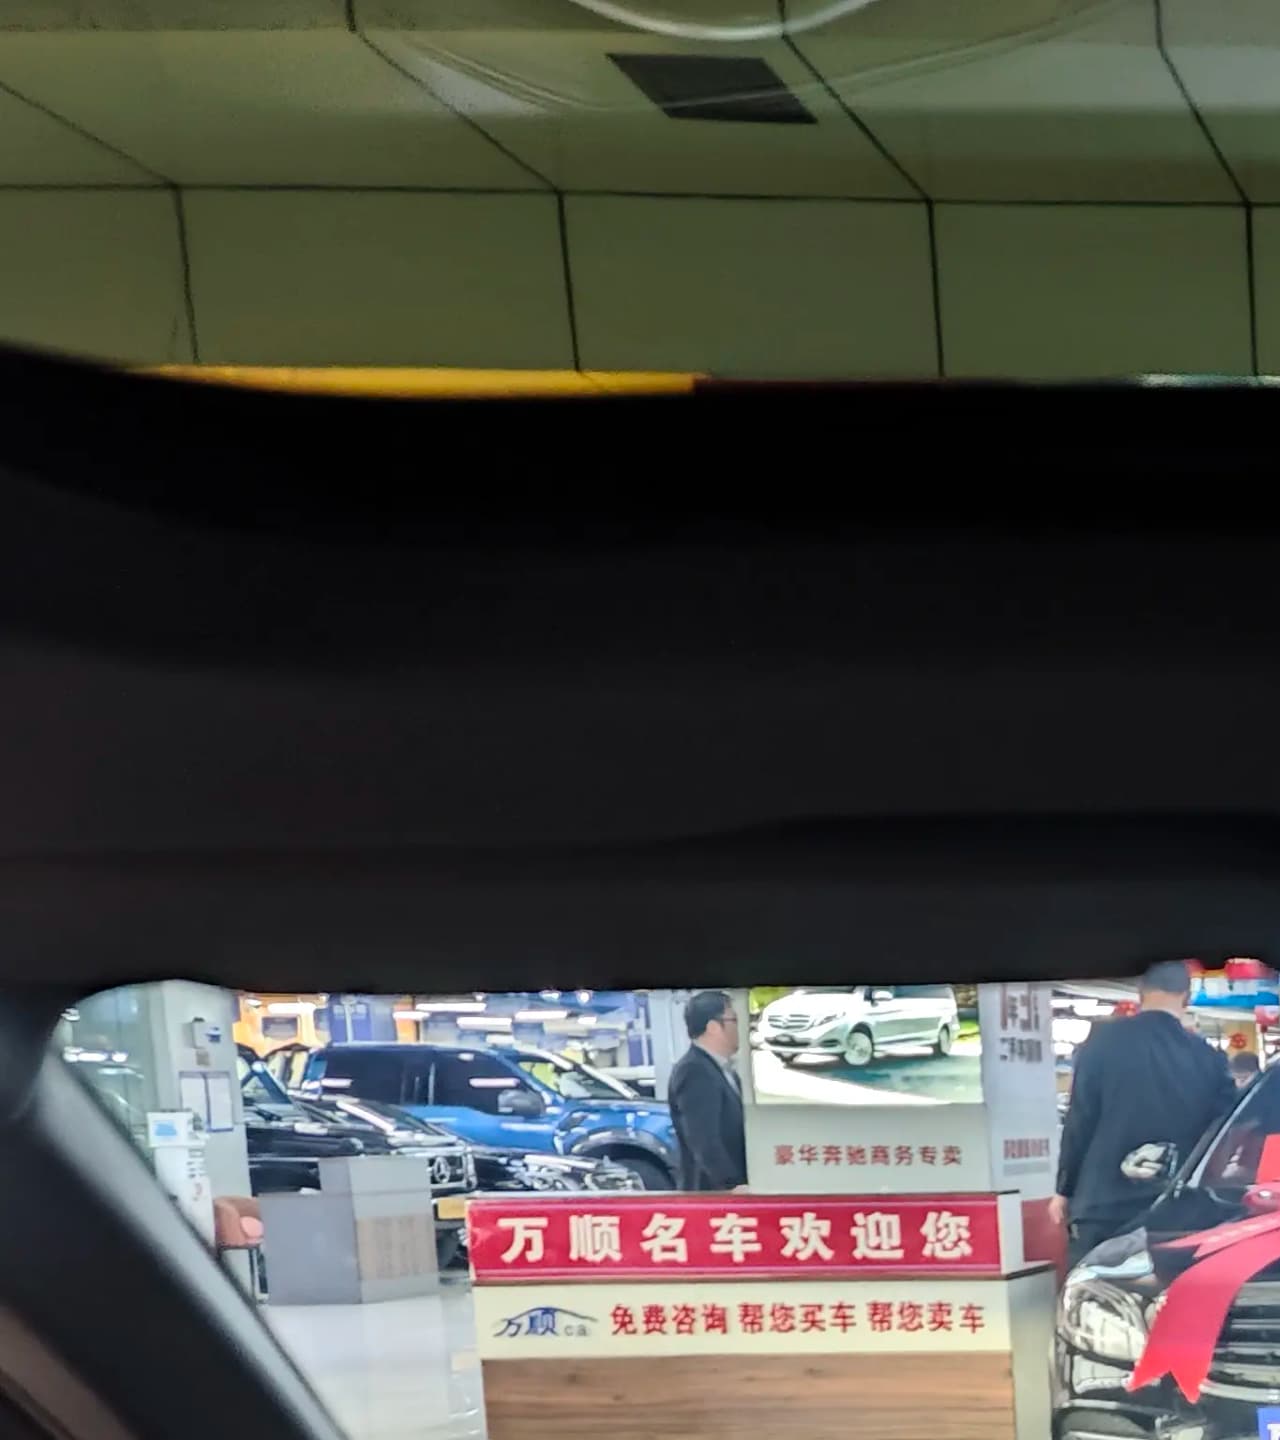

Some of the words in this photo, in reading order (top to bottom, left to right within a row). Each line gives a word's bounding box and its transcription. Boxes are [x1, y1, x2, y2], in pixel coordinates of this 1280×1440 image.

[773, 1144, 963, 1167] 豪华奔驰商务专卖
[496, 1211, 974, 1263] 万顺名车欢迎您
[610, 1303, 729, 1336] 免费咨询
[738, 1302, 857, 1334] 帮您买车
[866, 1301, 986, 1334] 帮您卖车
